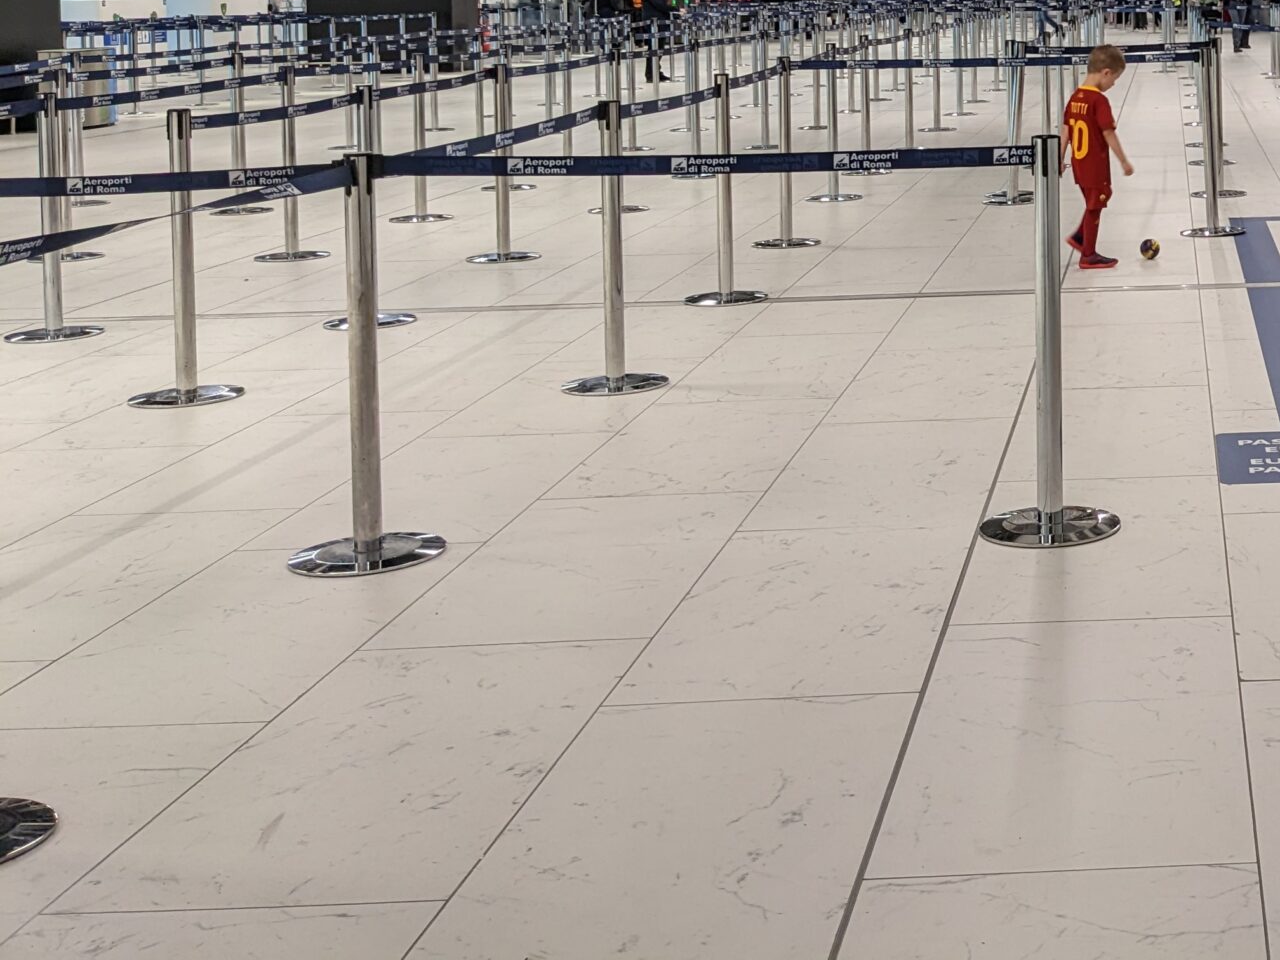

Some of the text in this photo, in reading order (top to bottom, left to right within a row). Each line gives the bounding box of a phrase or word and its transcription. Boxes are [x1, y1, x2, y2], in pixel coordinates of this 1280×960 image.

[689, 157, 737, 165] Aeroporti
[851, 152, 899, 162] Aeroporti
[525, 158, 574, 167] Aeroporti
[851, 161, 860, 169] di
[246, 167, 295, 178] Aeroporti
[525, 166, 535, 174] di
[689, 165, 698, 173] di
[84, 176, 132, 186] Aeroporti
[247, 177, 288, 186] di Roma
[84, 185, 126, 194] di Roma
